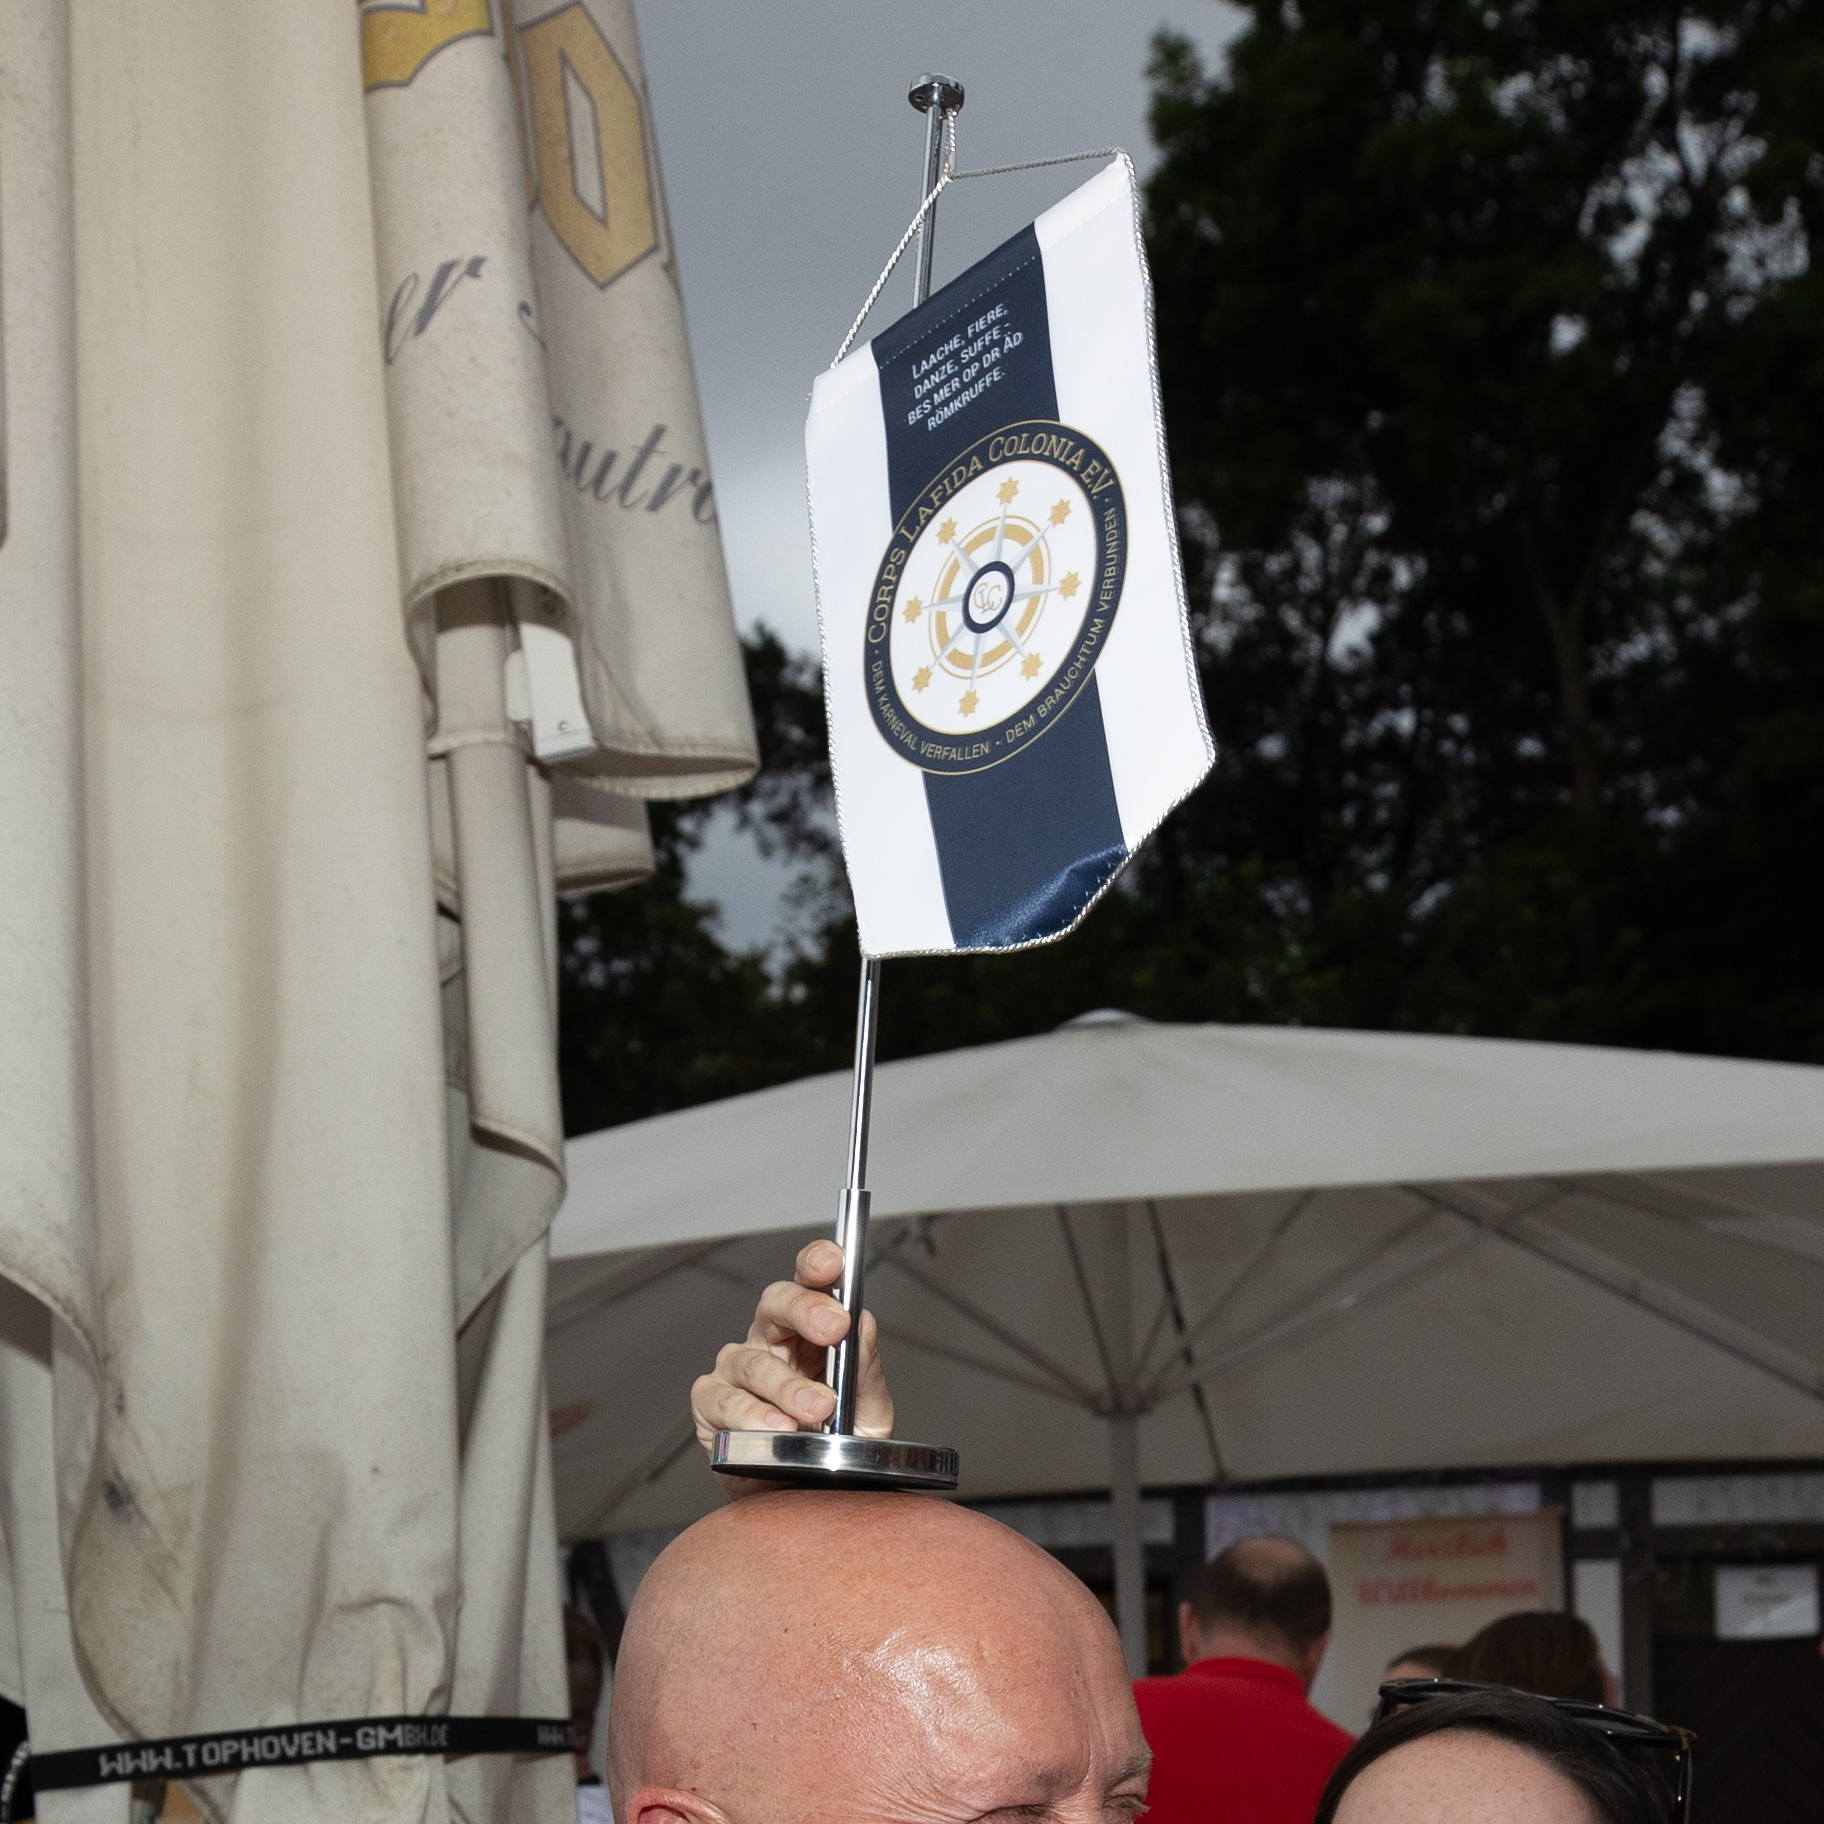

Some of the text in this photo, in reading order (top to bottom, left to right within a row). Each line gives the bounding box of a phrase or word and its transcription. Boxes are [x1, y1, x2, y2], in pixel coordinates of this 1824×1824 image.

[912, 303, 1009, 379] LAACHE, FIERE,
[907, 330, 1024, 425] BES MER OP DR ÄD
[914, 359, 959, 399] DANZE,
[927, 366, 1006, 431] RÖMKRUFFE.
[867, 547, 906, 644] CORPS
[900, 455, 984, 543] LAFIDA
[988, 432, 1084, 471] COLONIA
[1097, 506, 1121, 614] VERBUNDEN
[873, 660, 886, 695] DEM
[1037, 618, 1105, 719] BRAUCHTUM
[877, 693, 918, 751] KARNEVAL
[920, 740, 990, 761] VERFALLEN
[1005, 717, 1037, 744] DEM
